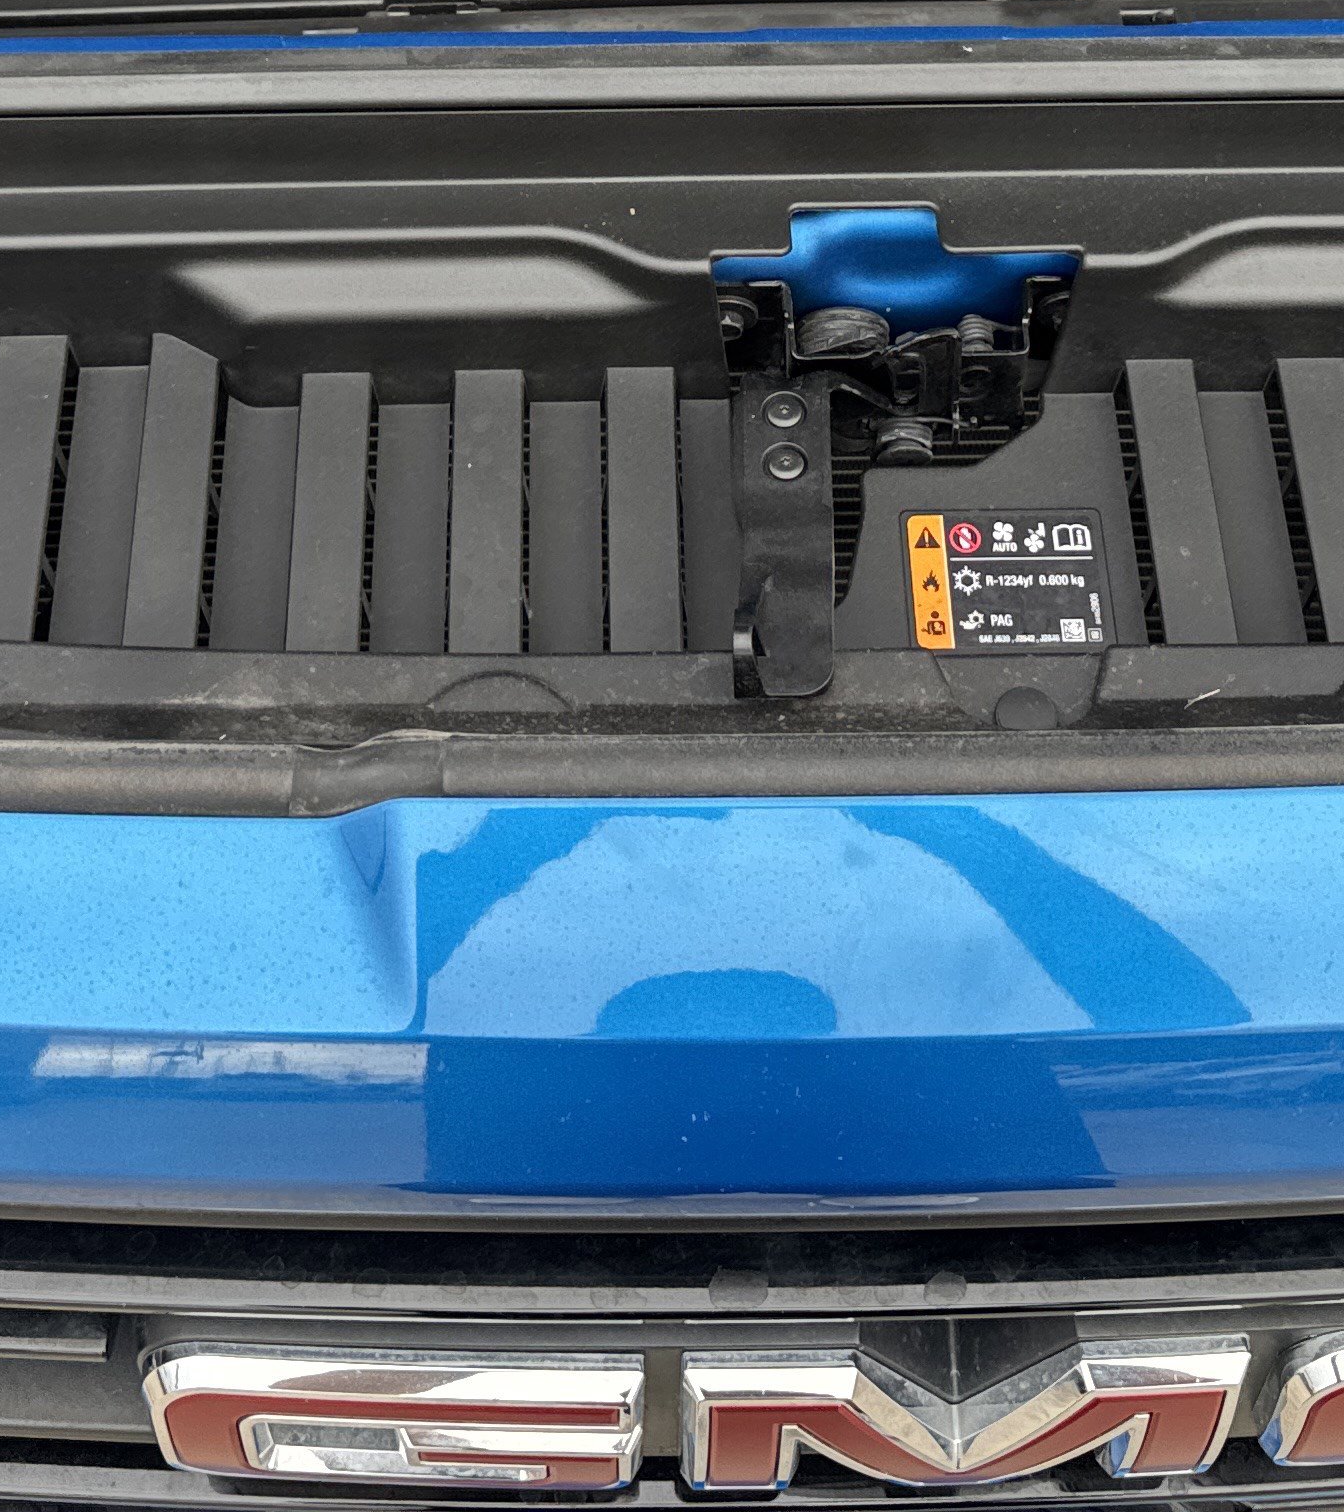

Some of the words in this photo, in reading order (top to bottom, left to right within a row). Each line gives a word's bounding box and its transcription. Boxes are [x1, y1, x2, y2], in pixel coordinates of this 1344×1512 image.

[992, 541, 1018, 553] AUTO
[985, 574, 1033, 588] R-1234yf
[1070, 574, 1085, 588] kg
[990, 614, 1013, 627] PAG
